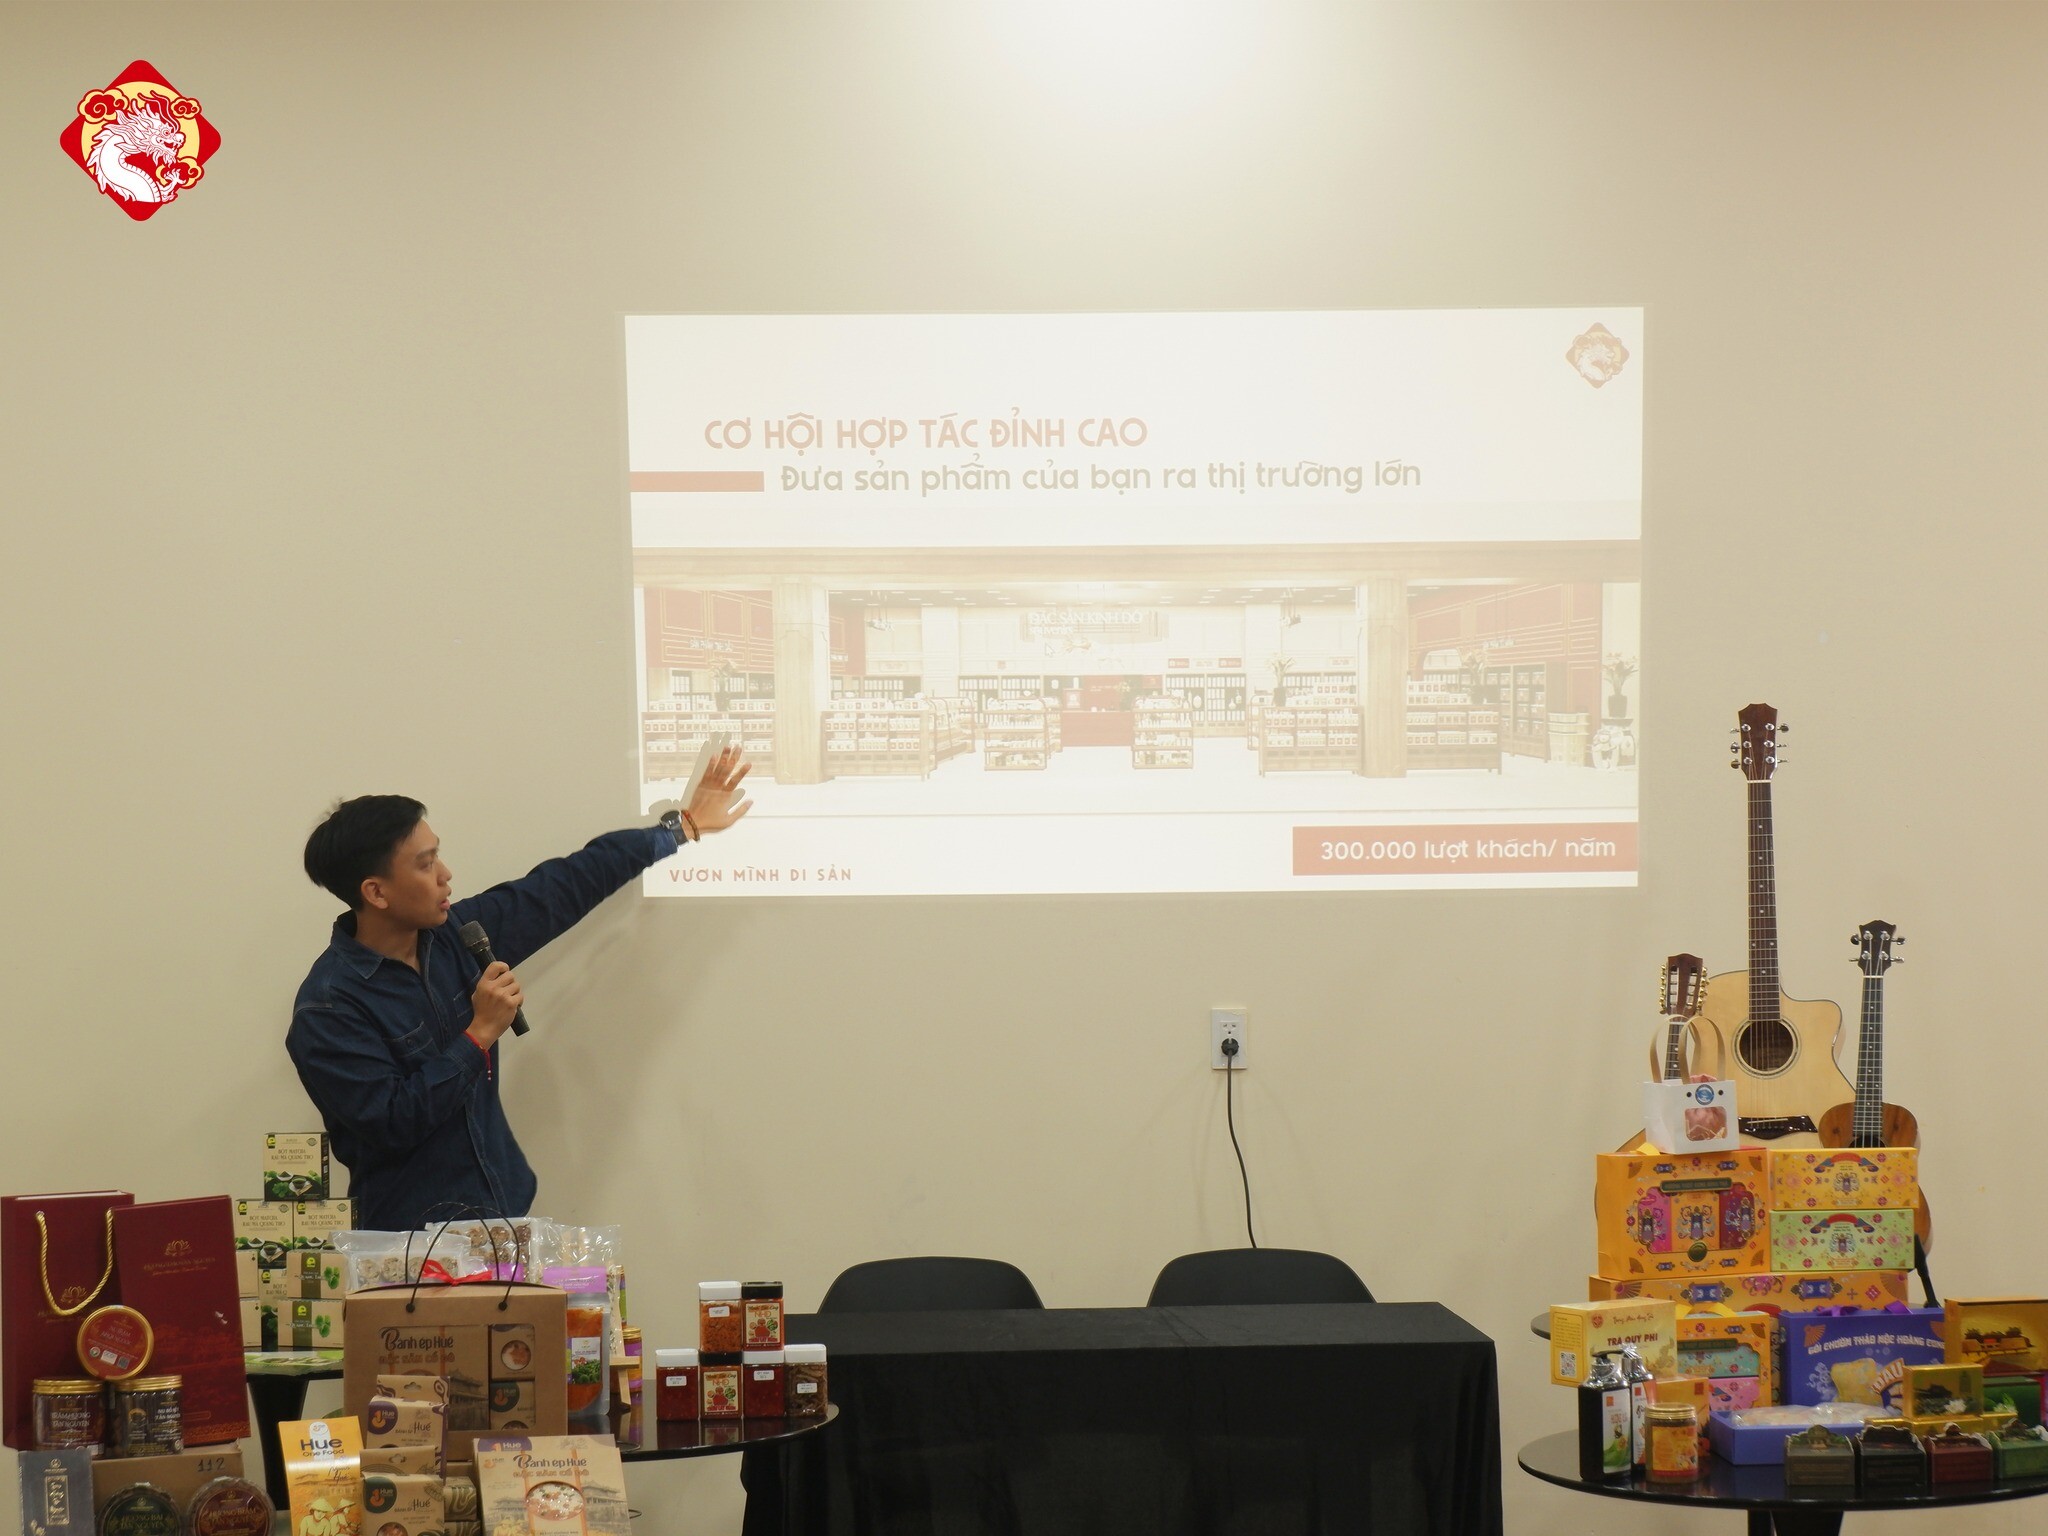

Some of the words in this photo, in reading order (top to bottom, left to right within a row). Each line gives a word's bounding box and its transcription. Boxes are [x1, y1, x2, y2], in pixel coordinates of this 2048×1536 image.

[704, 416, 752, 450] CƠ
[763, 411, 824, 457] HỘI
[836, 416, 908, 457] HỢP
[918, 412, 979, 449] TÁC
[989, 406, 1066, 448] ĐỈNH
[1077, 417, 1148, 448] CAO
[780, 464, 843, 492] Đưa
[854, 459, 910, 491] sản
[921, 452, 1011, 498] phẩm
[1022, 458, 1079, 490] của
[1090, 463, 1151, 496] bạn
[1162, 467, 1196, 489] ra
[1207, 461, 1246, 495] thị
[1255, 460, 1363, 494] trường
[1374, 458, 1421, 487] lớn
[1320, 840, 1416, 860] 300.000
[1424, 838, 1469, 863] lượt
[1476, 837, 1558, 859] khách/
[1565, 836, 1616, 857] năm
[669, 867, 723, 882] VƯƠN
[733, 865, 780, 882] MÌNH
[790, 869, 807, 882] DI
[817, 864, 852, 881] SẢN
[1644, 1332, 1658, 1342] PHI
[300, 1438, 343, 1451] Hue
